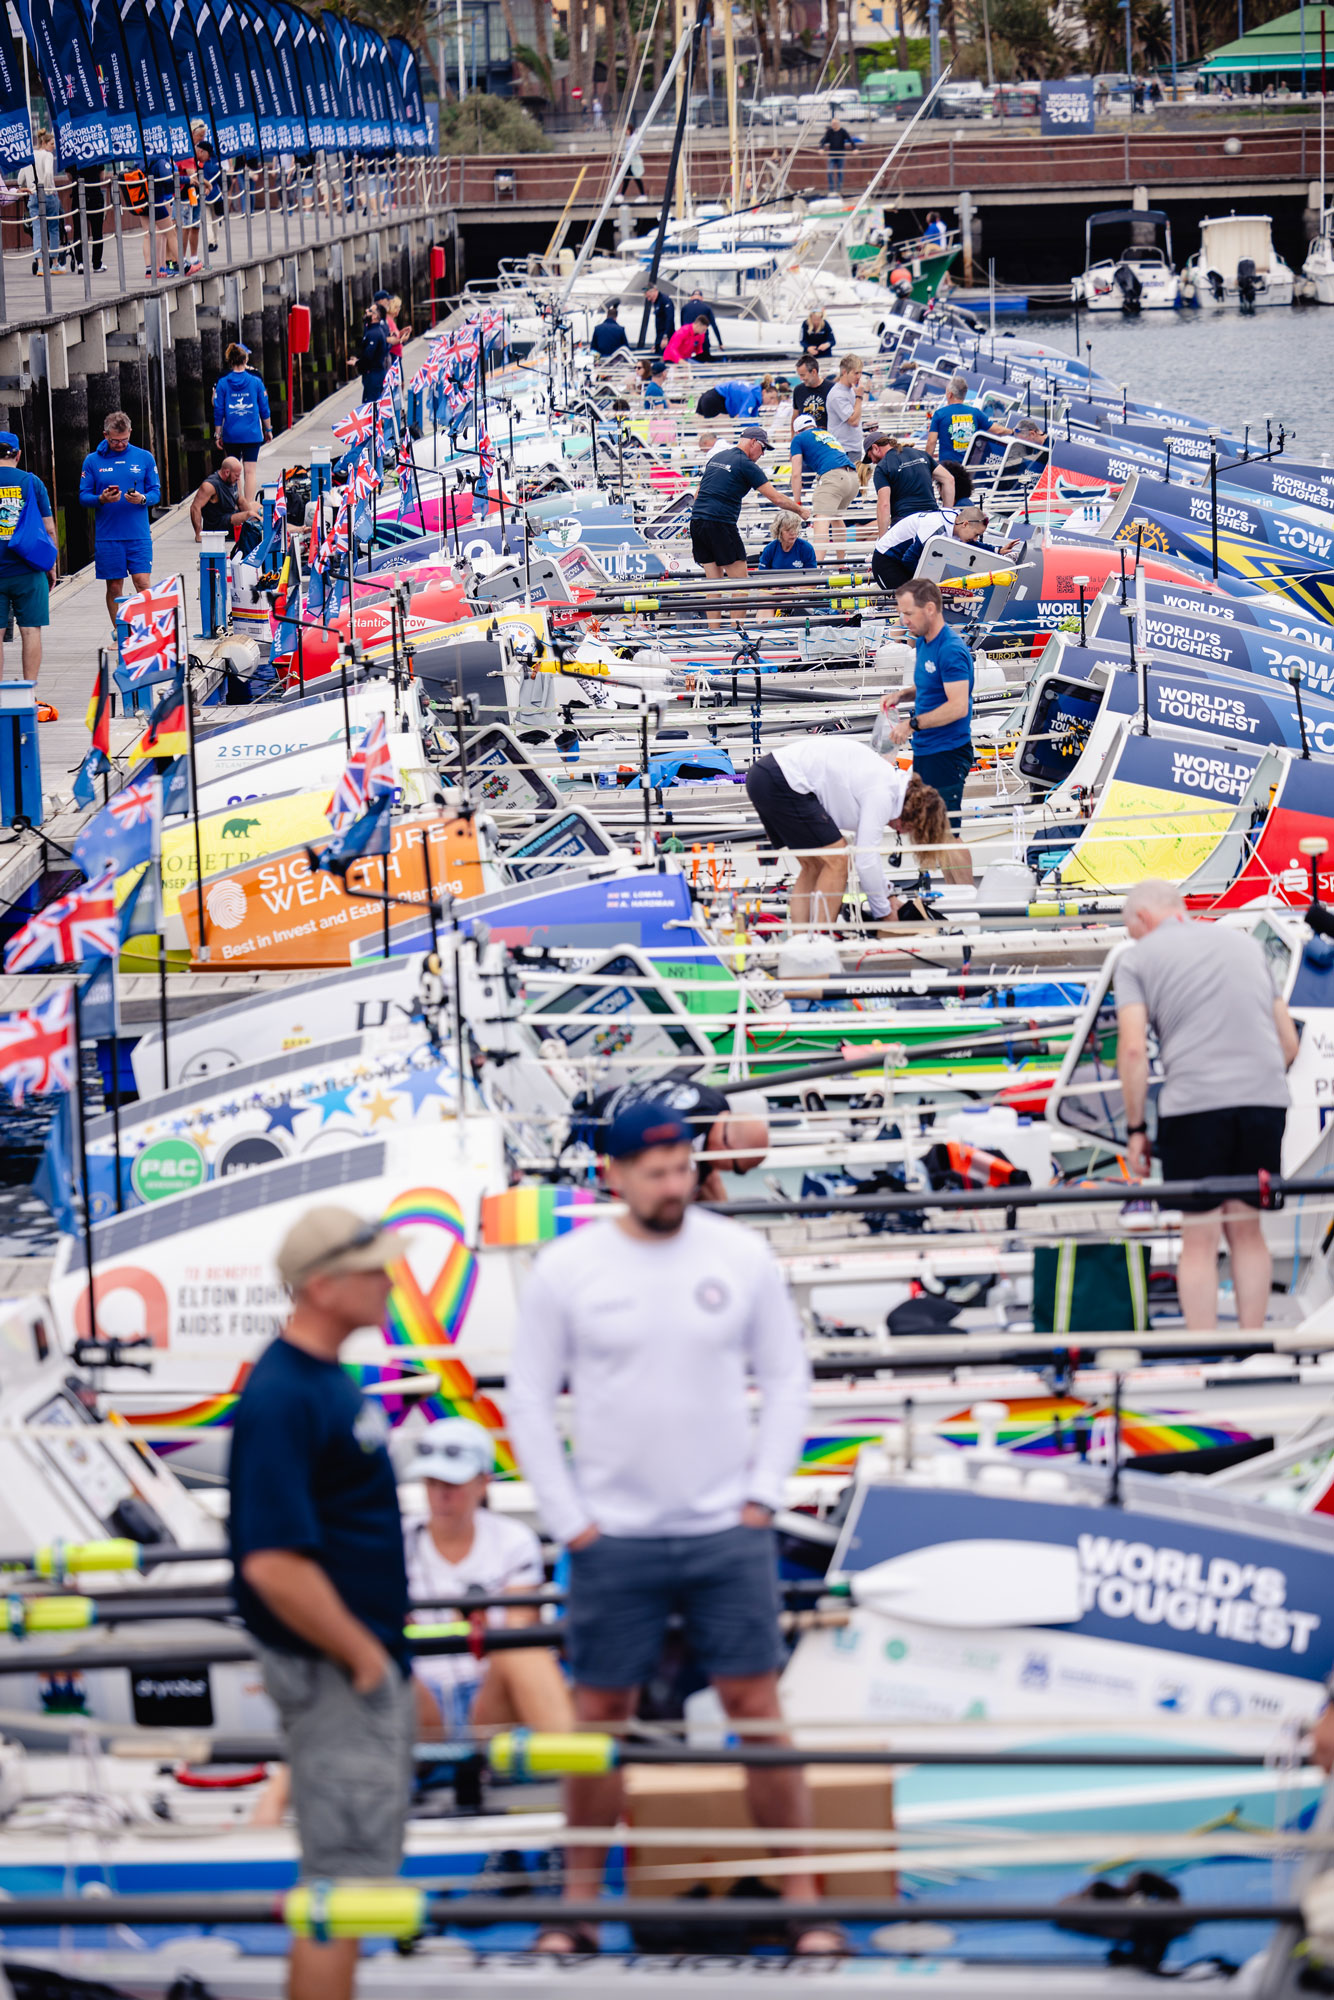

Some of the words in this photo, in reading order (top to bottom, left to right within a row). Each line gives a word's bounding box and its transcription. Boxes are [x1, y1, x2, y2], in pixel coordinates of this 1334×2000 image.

[43, 30, 55, 57] MATES
[71, 38, 82, 63] BUOYS
[51, 58, 65, 88] MIGHTY
[187, 51, 198, 81] ATLANTIC
[77, 65, 95, 107] OARDINARY
[110, 52, 126, 109] PAROARMEDICS
[161, 72, 172, 91] FLOW
[59, 89, 68, 106] OAR
[146, 90, 156, 111] TEAM
[168, 97, 177, 112] EBB
[193, 81, 203, 112] INVICTUS
[216, 84, 229, 115] ATLANTIC
[0, 129, 29, 146] OUGHEST
[73, 130, 107, 145] OUGHEST
[1271, 481, 1334, 509] TOUGHEST
[1272, 473, 1329, 497] WORLD'S
[1189, 506, 1258, 535] TOUGHEST
[1190, 497, 1249, 522] WORLD'S
[1163, 594, 1235, 621] WORLD'S
[346, 616, 387, 629] atlantic
[1145, 619, 1222, 647] WORLD'S
[1145, 631, 1233, 662] TOUGHEST
[1158, 685, 1246, 716] WORLD'S
[1157, 698, 1260, 734] TOUGHEST
[217, 746, 227, 758] 2
[1173, 751, 1257, 780] WORLD'
[1171, 765, 1251, 797] TOUGH
[221, 937, 247, 960] Best
[249, 932, 272, 950] in
[273, 919, 318, 946] Invest
[319, 911, 348, 931] and
[140, 1158, 199, 1179] P&C
[177, 1285, 238, 1309] ELTON
[177, 1312, 223, 1336] AIDS
[1077, 1533, 1287, 1609] WORLD'S
[1082, 1573, 1321, 1655] TOUGHEST
